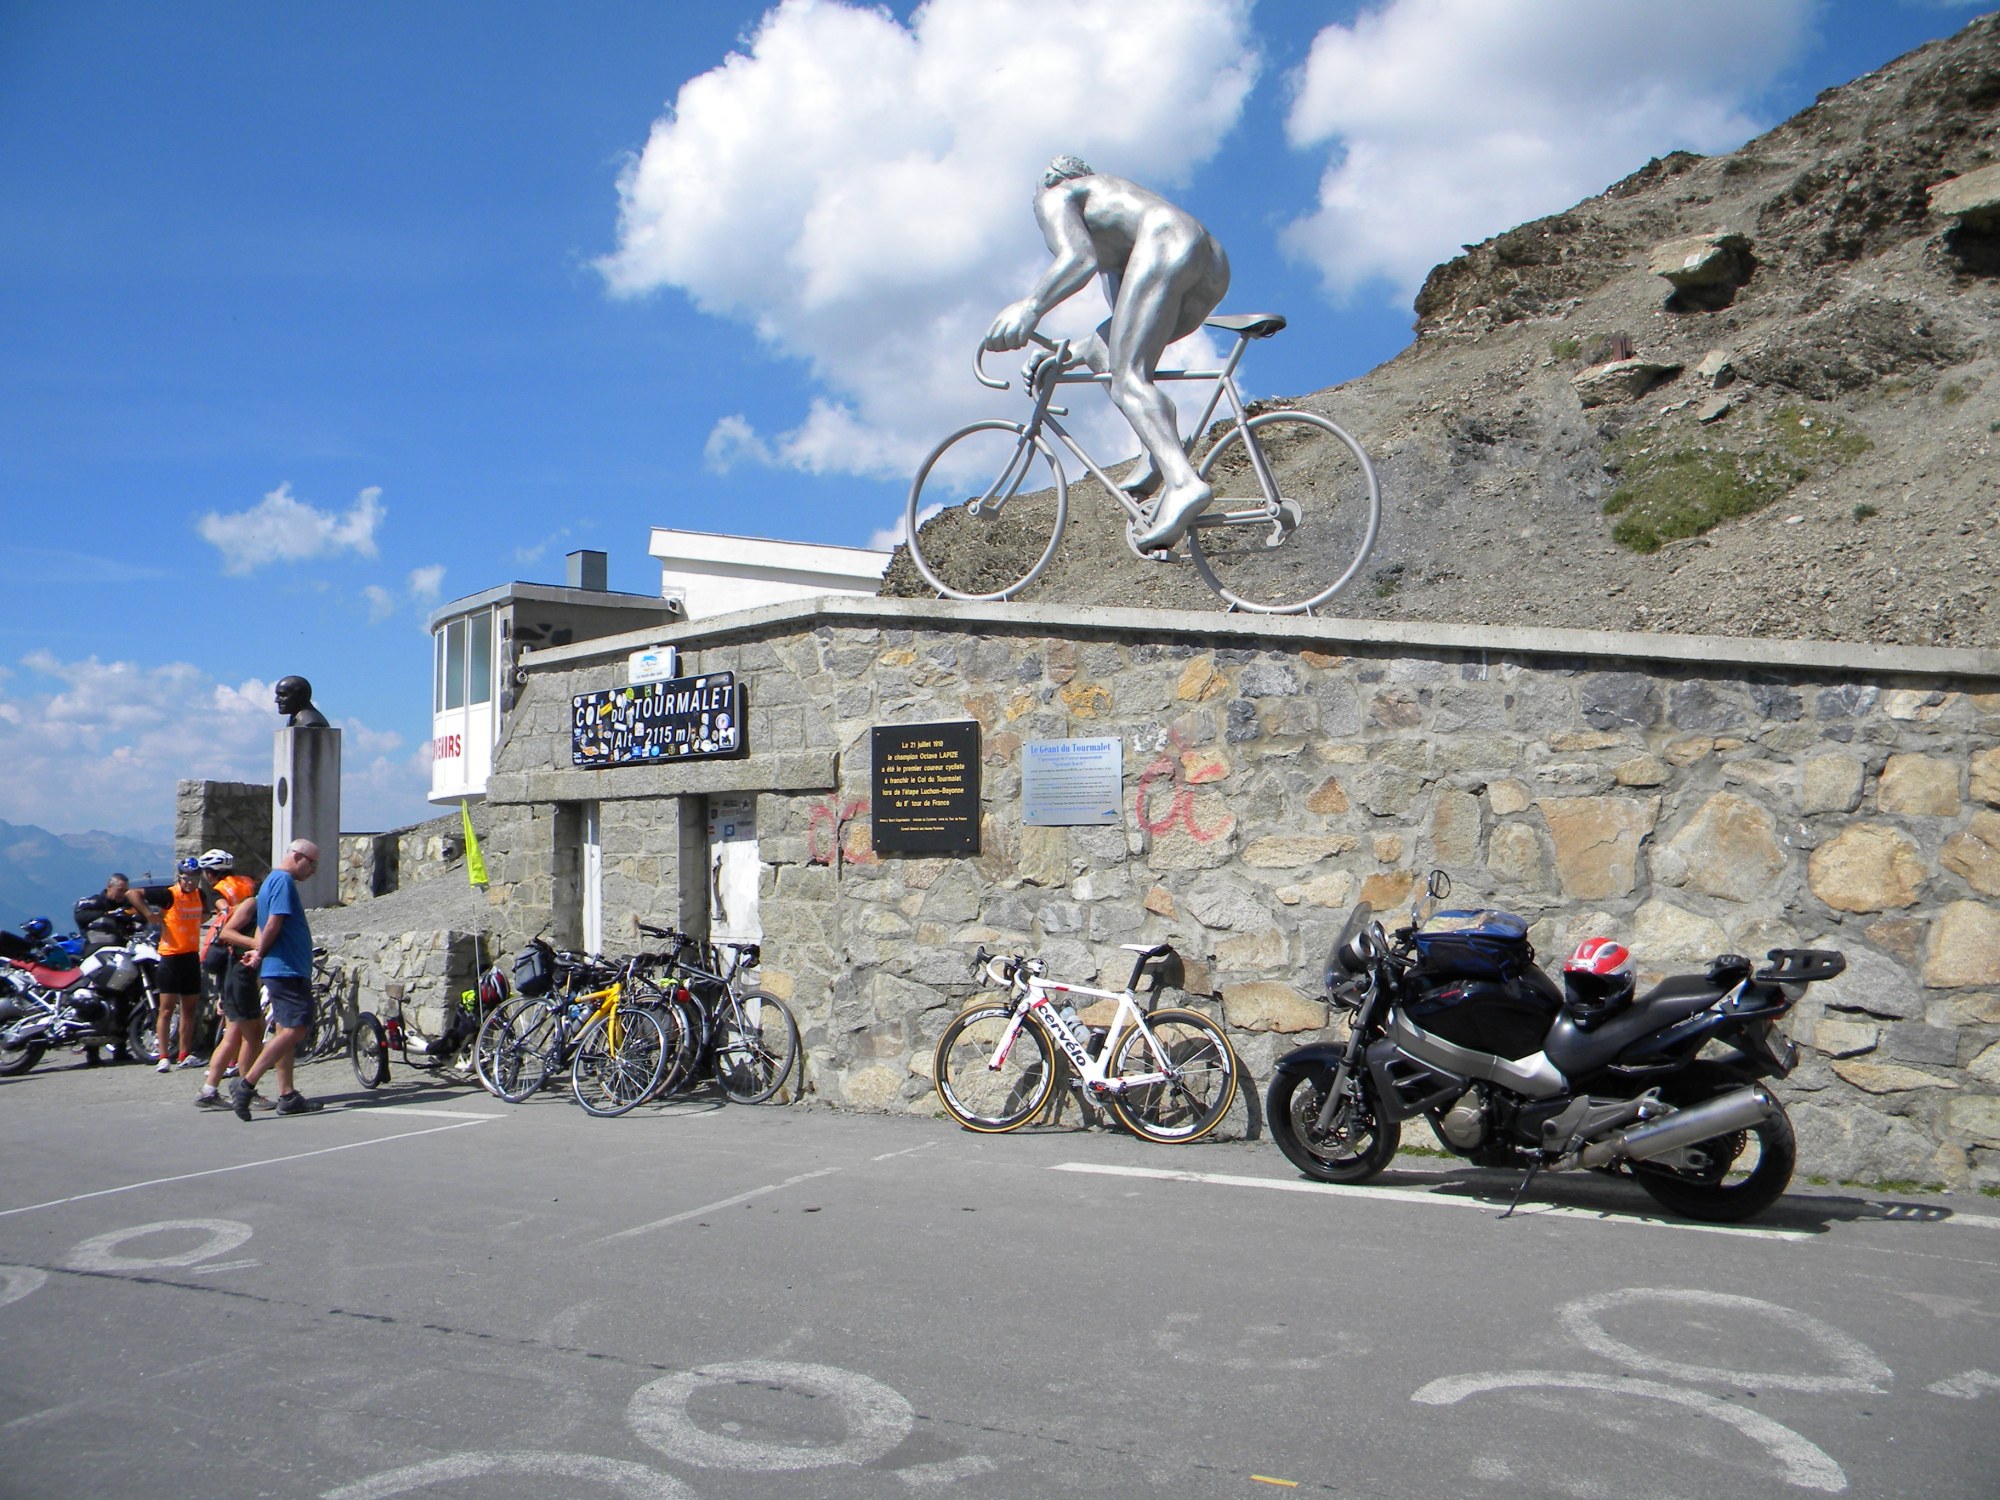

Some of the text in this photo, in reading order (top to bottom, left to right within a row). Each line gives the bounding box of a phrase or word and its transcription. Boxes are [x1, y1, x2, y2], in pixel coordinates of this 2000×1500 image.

[611, 707, 625, 723] DU
[634, 685, 732, 720] TOURMALET
[610, 722, 691, 751] (Alt. 2115 m)
[902, 741, 908, 749] Le
[917, 740, 931, 750] juillet
[1030, 742, 1111, 754] Le Géant du Tourmalet
[894, 753, 919, 762] champion
[902, 765, 922, 774] premier
[945, 763, 965, 772] cycliste
[902, 788, 919, 796] l'étape
[920, 787, 964, 795] Luchon-Bayonne
[1038, 1005, 1086, 1066] cervélo
